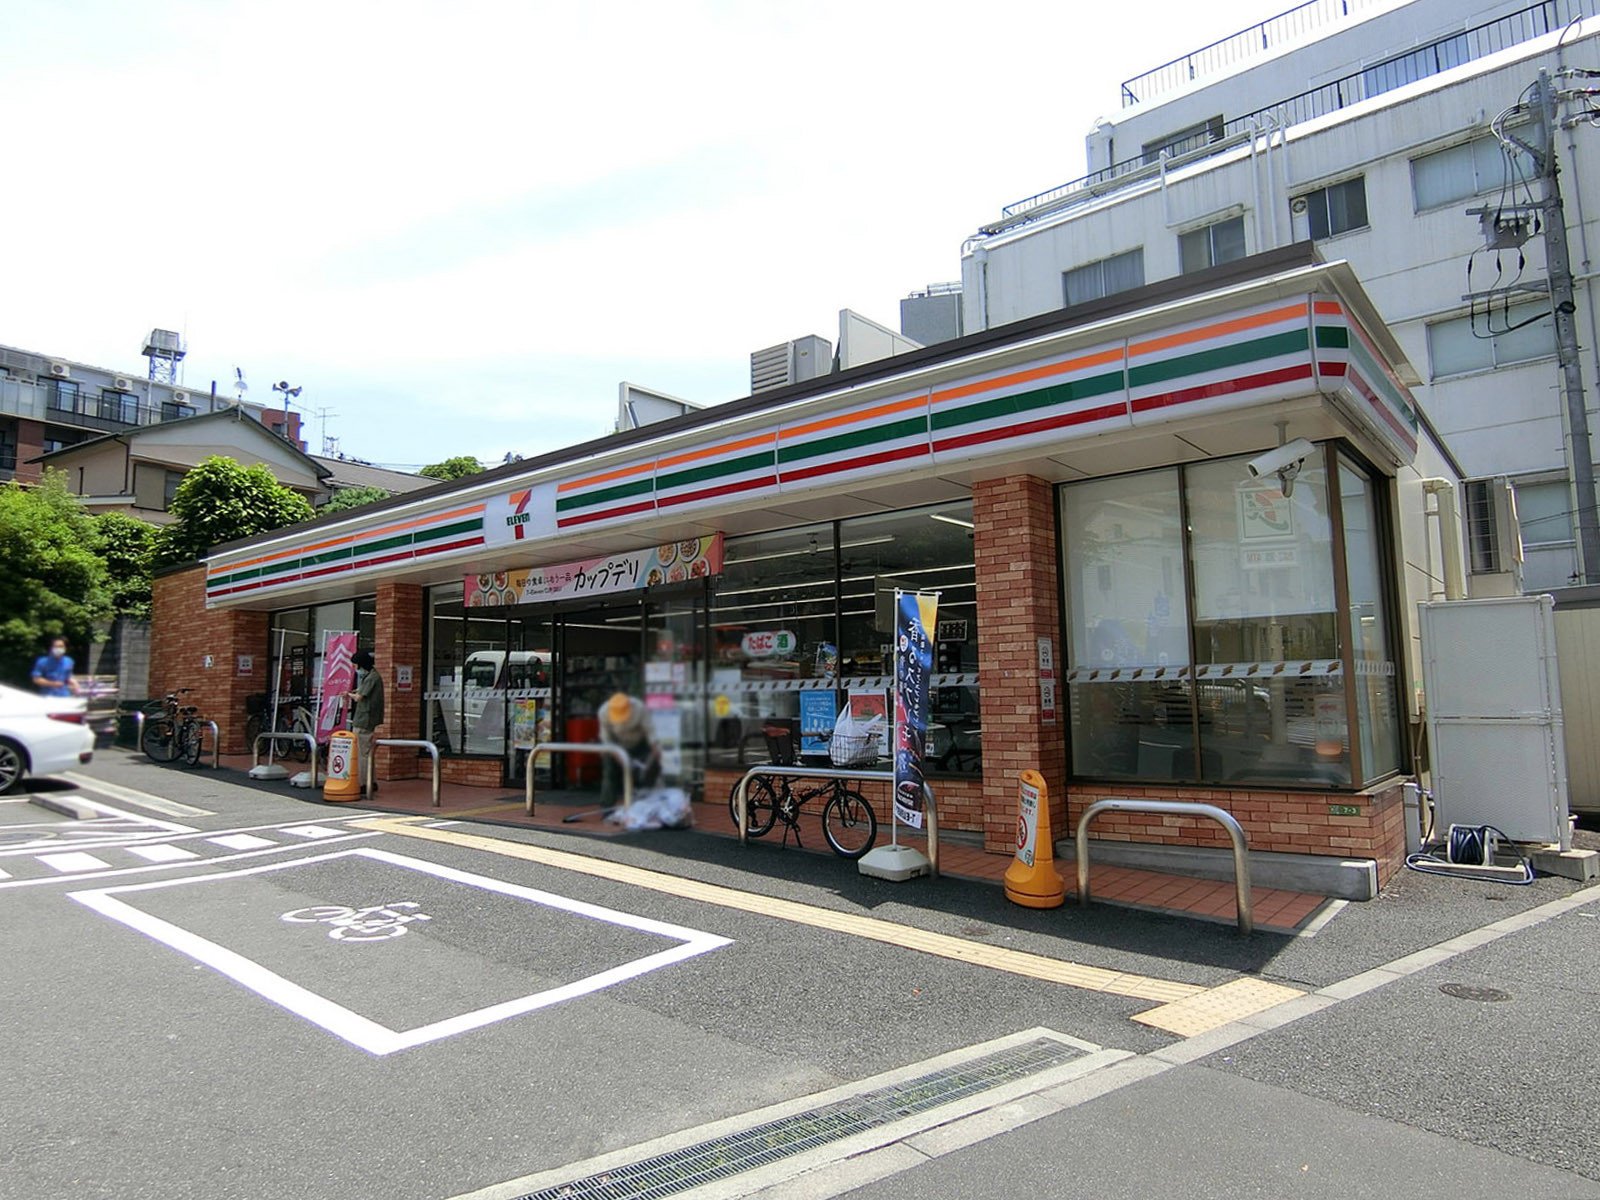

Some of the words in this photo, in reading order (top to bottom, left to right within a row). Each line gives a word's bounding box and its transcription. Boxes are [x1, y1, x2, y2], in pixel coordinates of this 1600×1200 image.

[509, 489, 532, 539] 7
[573, 559, 639, 592] カップデリ
[748, 635, 773, 650] たばこ
[776, 633, 789, 649] 酒
